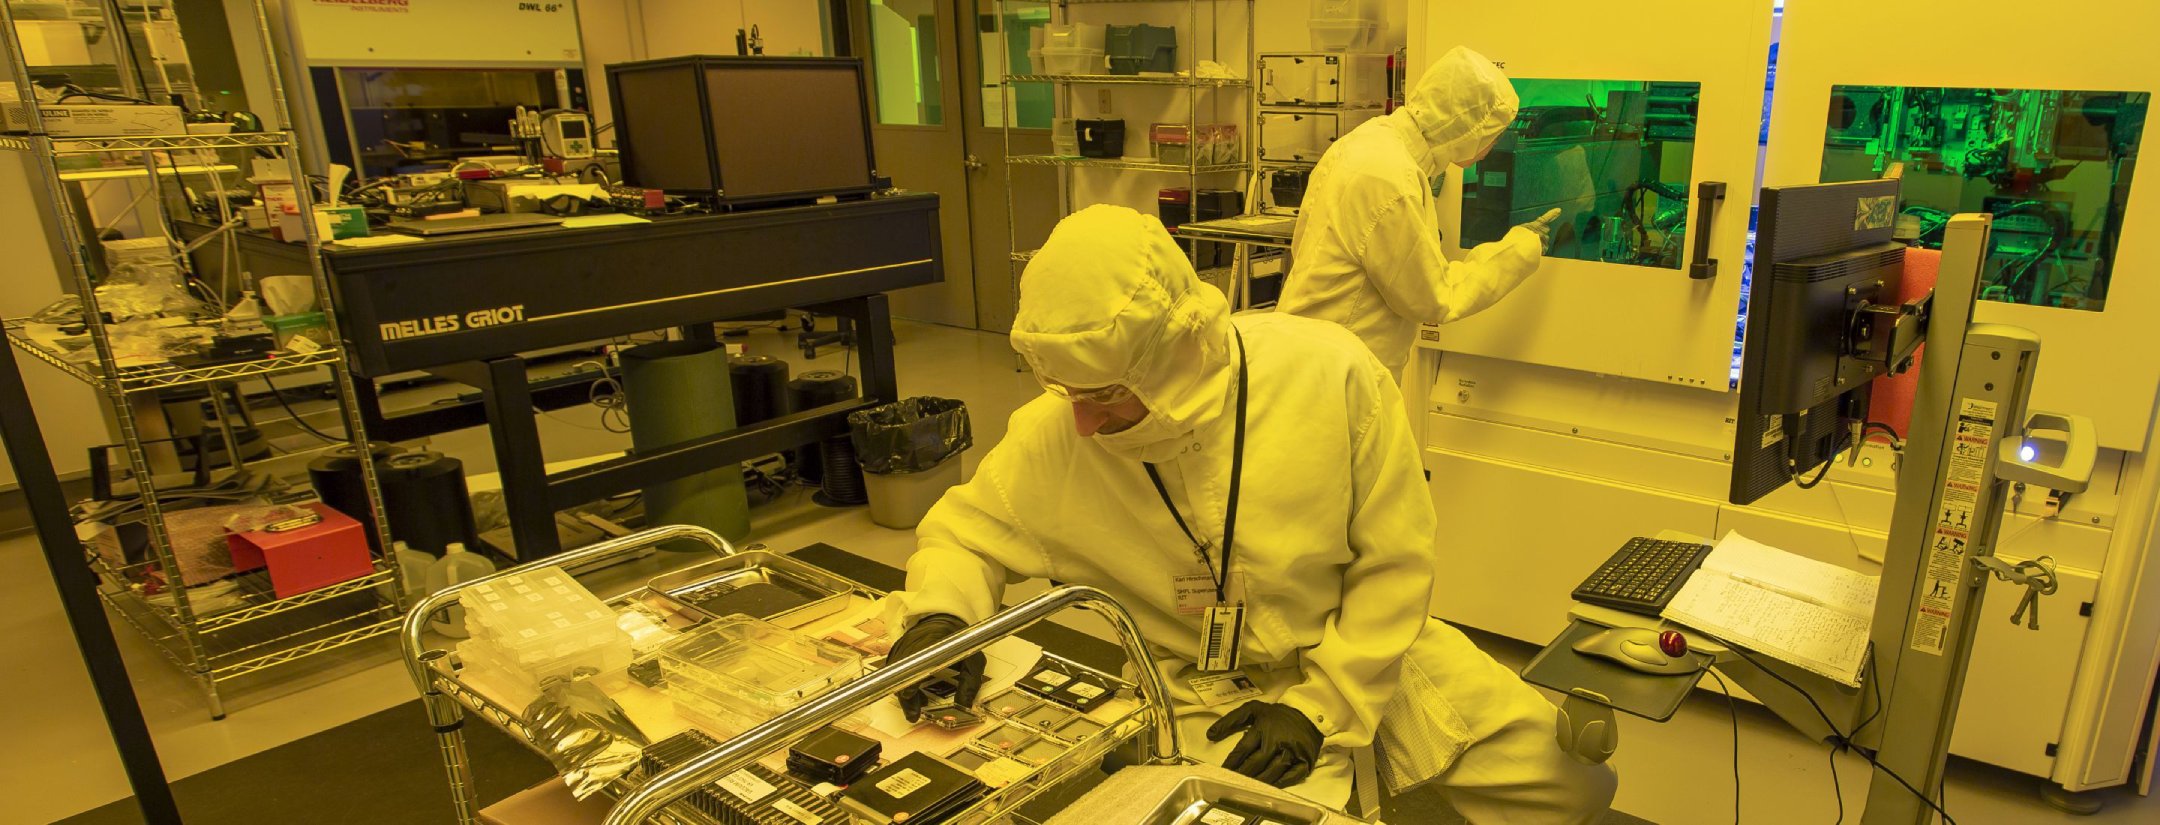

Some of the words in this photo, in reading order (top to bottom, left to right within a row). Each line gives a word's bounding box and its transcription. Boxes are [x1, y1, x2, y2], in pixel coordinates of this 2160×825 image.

[518, 2, 541, 12] DWL
[379, 314, 460, 341] MELLES
[465, 304, 524, 329] GRIOT
[1963, 435, 1988, 445] WARNING
[1953, 483, 1978, 492] WARNING
[1943, 530, 1967, 539] WARNING
[1926, 607, 1951, 618] WARNING
